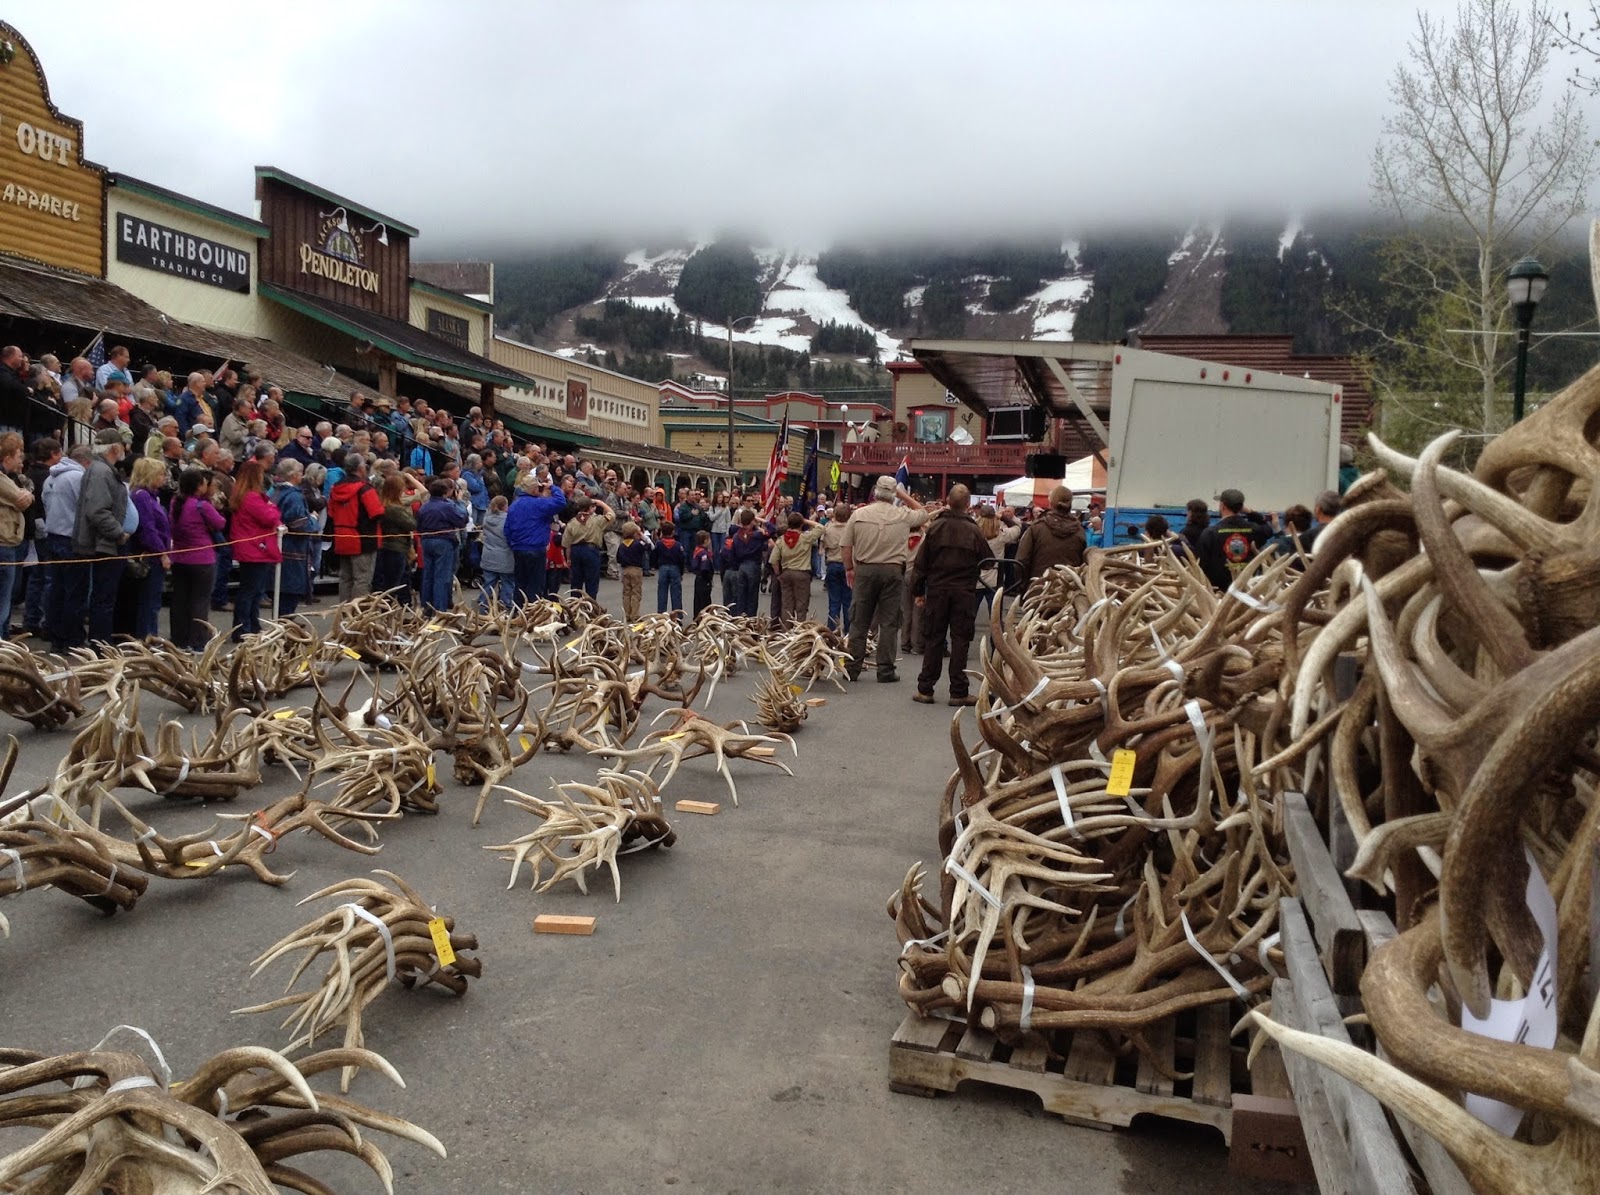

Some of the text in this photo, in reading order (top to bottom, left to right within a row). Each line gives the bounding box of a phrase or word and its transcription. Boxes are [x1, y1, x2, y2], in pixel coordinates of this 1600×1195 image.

[16, 122, 72, 167] OUT
[2, 183, 80, 222] APPAREL
[123, 218, 247, 275] EARTHBOUND
[318, 217, 343, 246] JACKSO
[152, 257, 205, 279] TRADING
[300, 241, 379, 294] PENDLETON
[589, 397, 647, 421] OUTFITTERS
